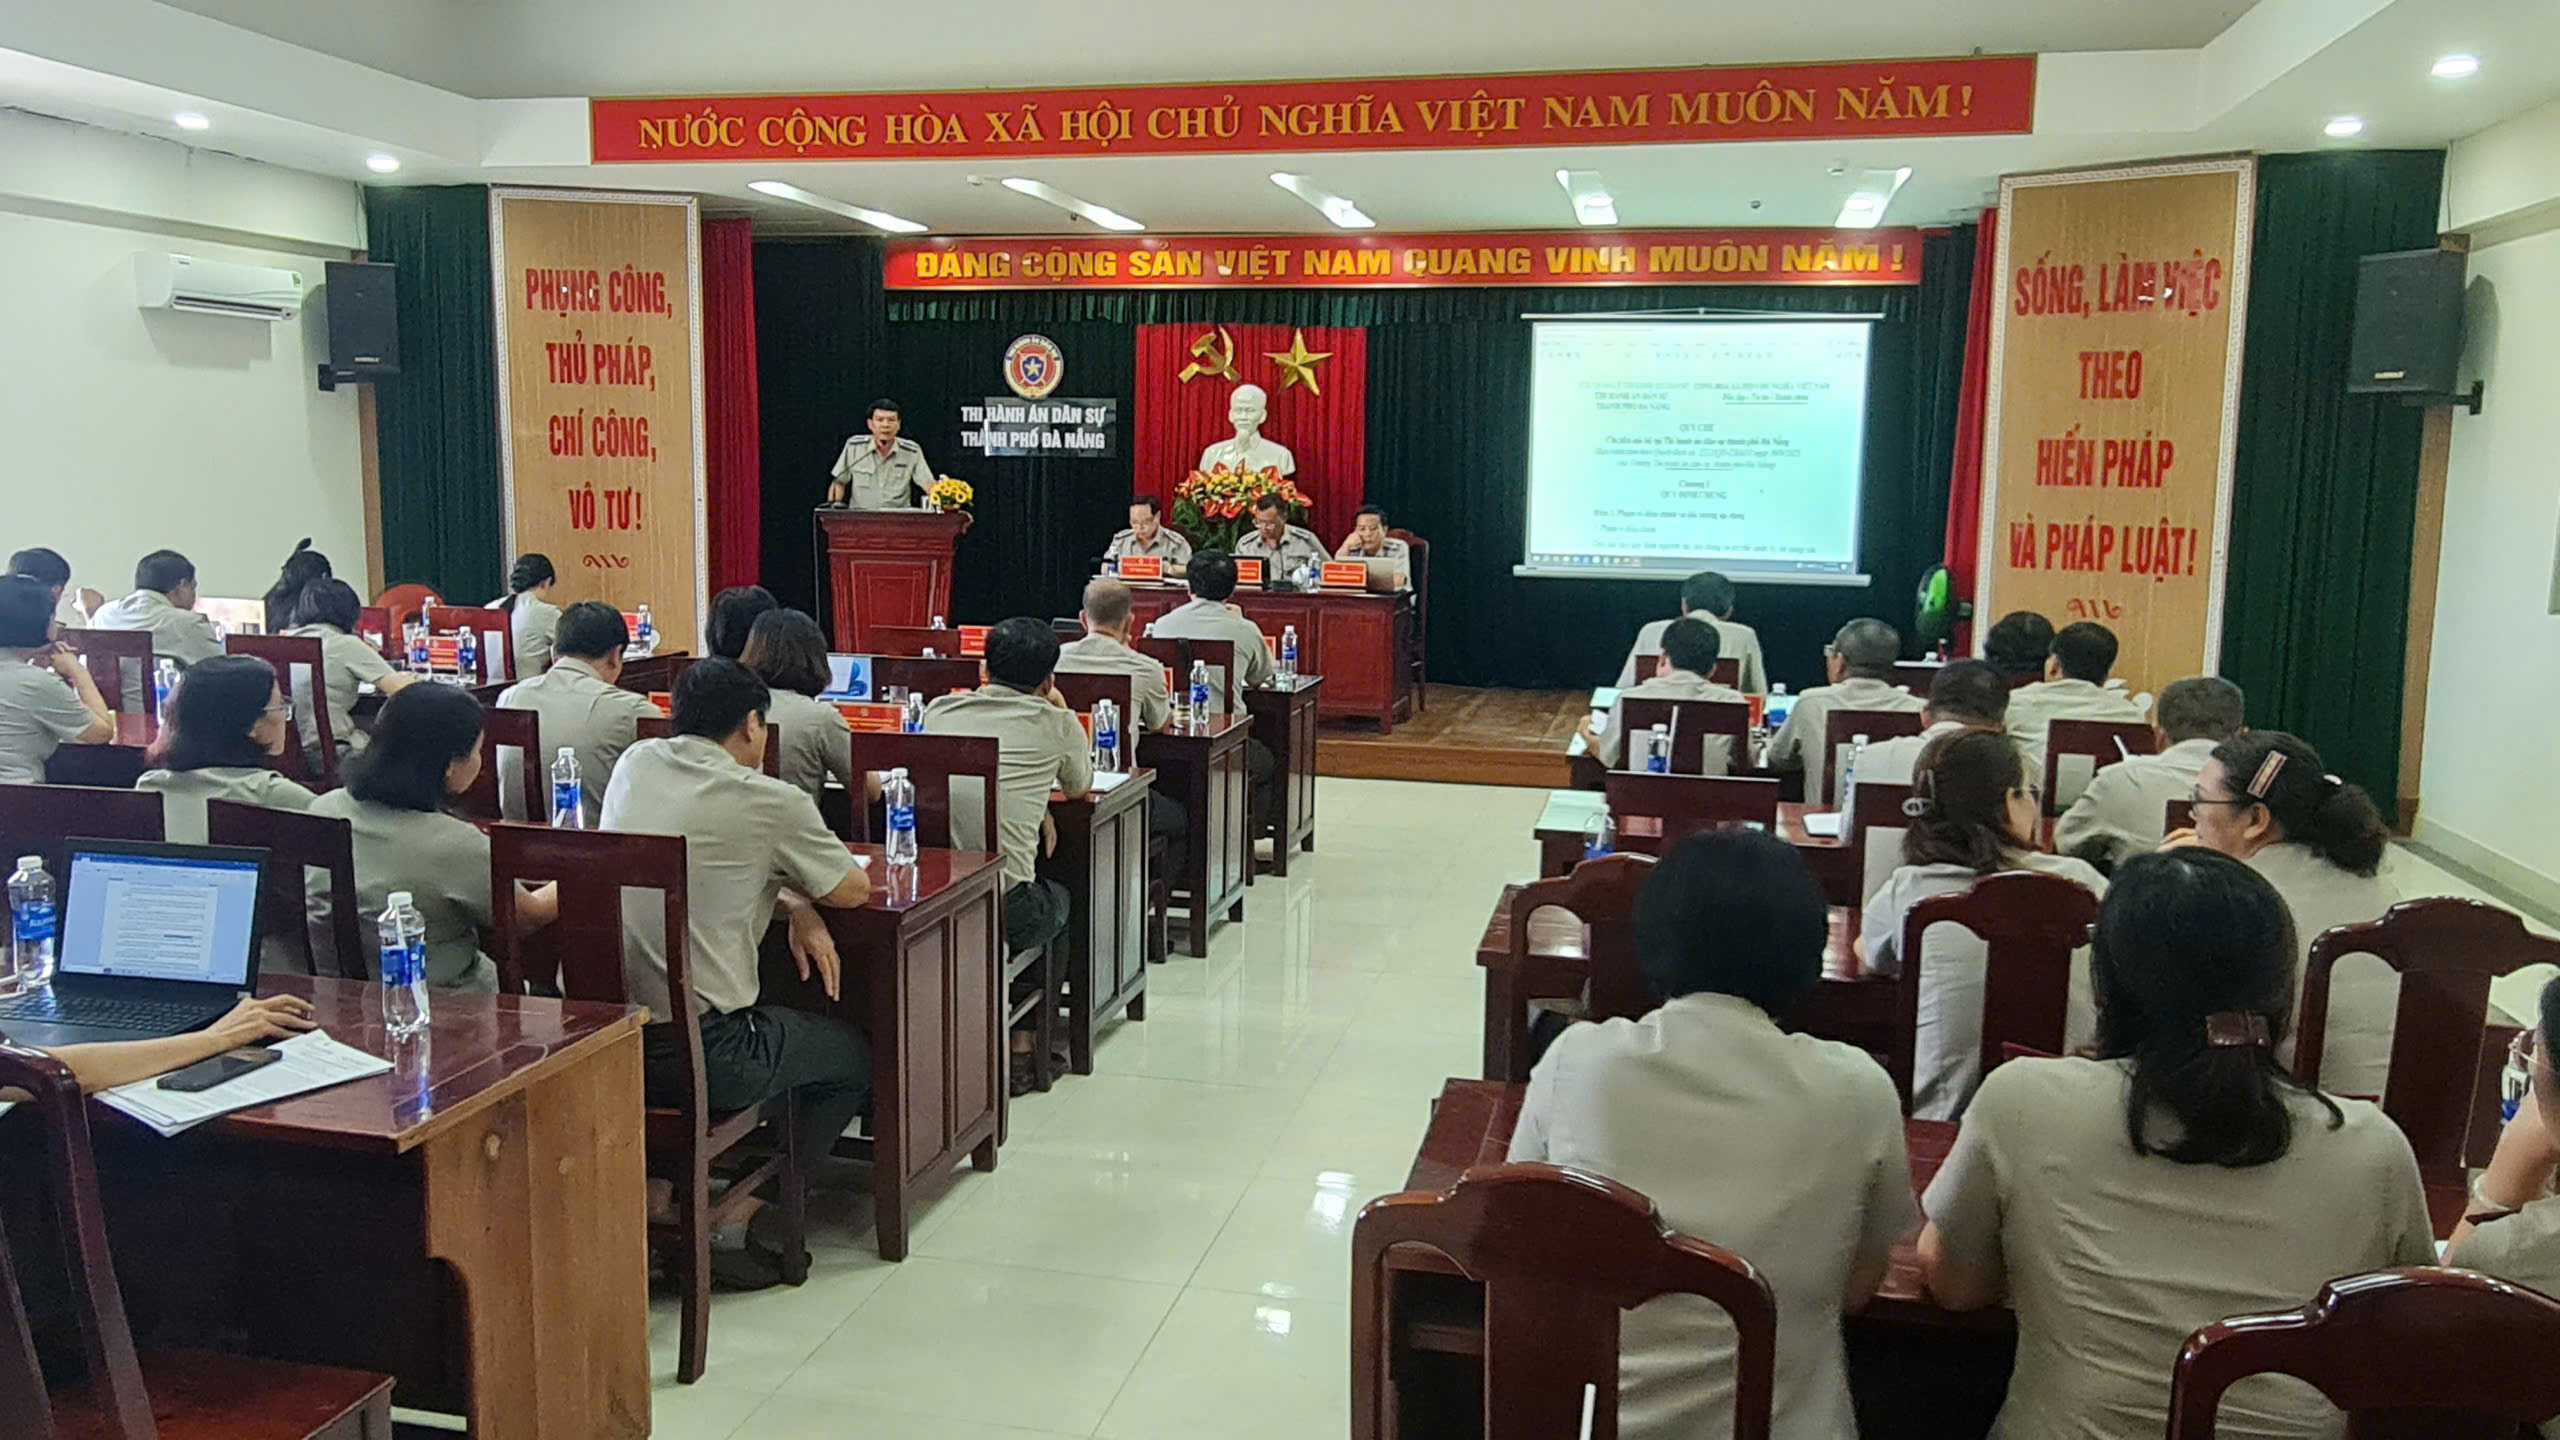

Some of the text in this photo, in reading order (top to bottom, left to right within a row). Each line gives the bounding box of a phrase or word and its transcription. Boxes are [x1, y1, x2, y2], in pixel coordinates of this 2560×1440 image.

[638, 106, 745, 151] NƯỚC
[757, 105, 868, 153] CỘNG
[884, 104, 968, 148] HÒA
[985, 102, 1045, 145] XÃ
[1058, 100, 1134, 150] HỘI
[1146, 95, 1242, 139] CHỦ
[1257, 93, 1404, 138] NGHĨA
[1416, 90, 1526, 139] VIỆT
[1542, 93, 1650, 130] NAM
[1667, 80, 1816, 126] MUÔN
[915, 245, 1012, 278] ĐẢNG
[1021, 246, 1118, 281] CỘNG
[1129, 241, 1203, 277] SẢN
[1215, 243, 1292, 280] VIỆT
[1303, 248, 1392, 277] NAM
[1402, 247, 1531, 277] QUANG
[1545, 245, 1637, 274] VINH
[1648, 239, 1769, 273] MUÔN
[2014, 249, 2090, 319] SỐNG,
[2098, 251, 2157, 313] LÀM
[525, 263, 672, 320] PHỤNG CÔNG,
[545, 329, 656, 391] THỦ PHÁP,
[2079, 350, 2143, 400] THEO
[548, 407, 657, 462] CHÍ CÔNG,
[960, 403, 1107, 427] THI HÀNH ÁN DÂN SỰ
[1010, 426, 1039, 448] PHỐ
[1041, 429, 1062, 448] ĐÀ
[2035, 423, 2175, 488] HIẾN PHÁP
[568, 481, 596, 530] VÔ
[2010, 512, 2198, 583] VÀ PHÁP LUẬT!
